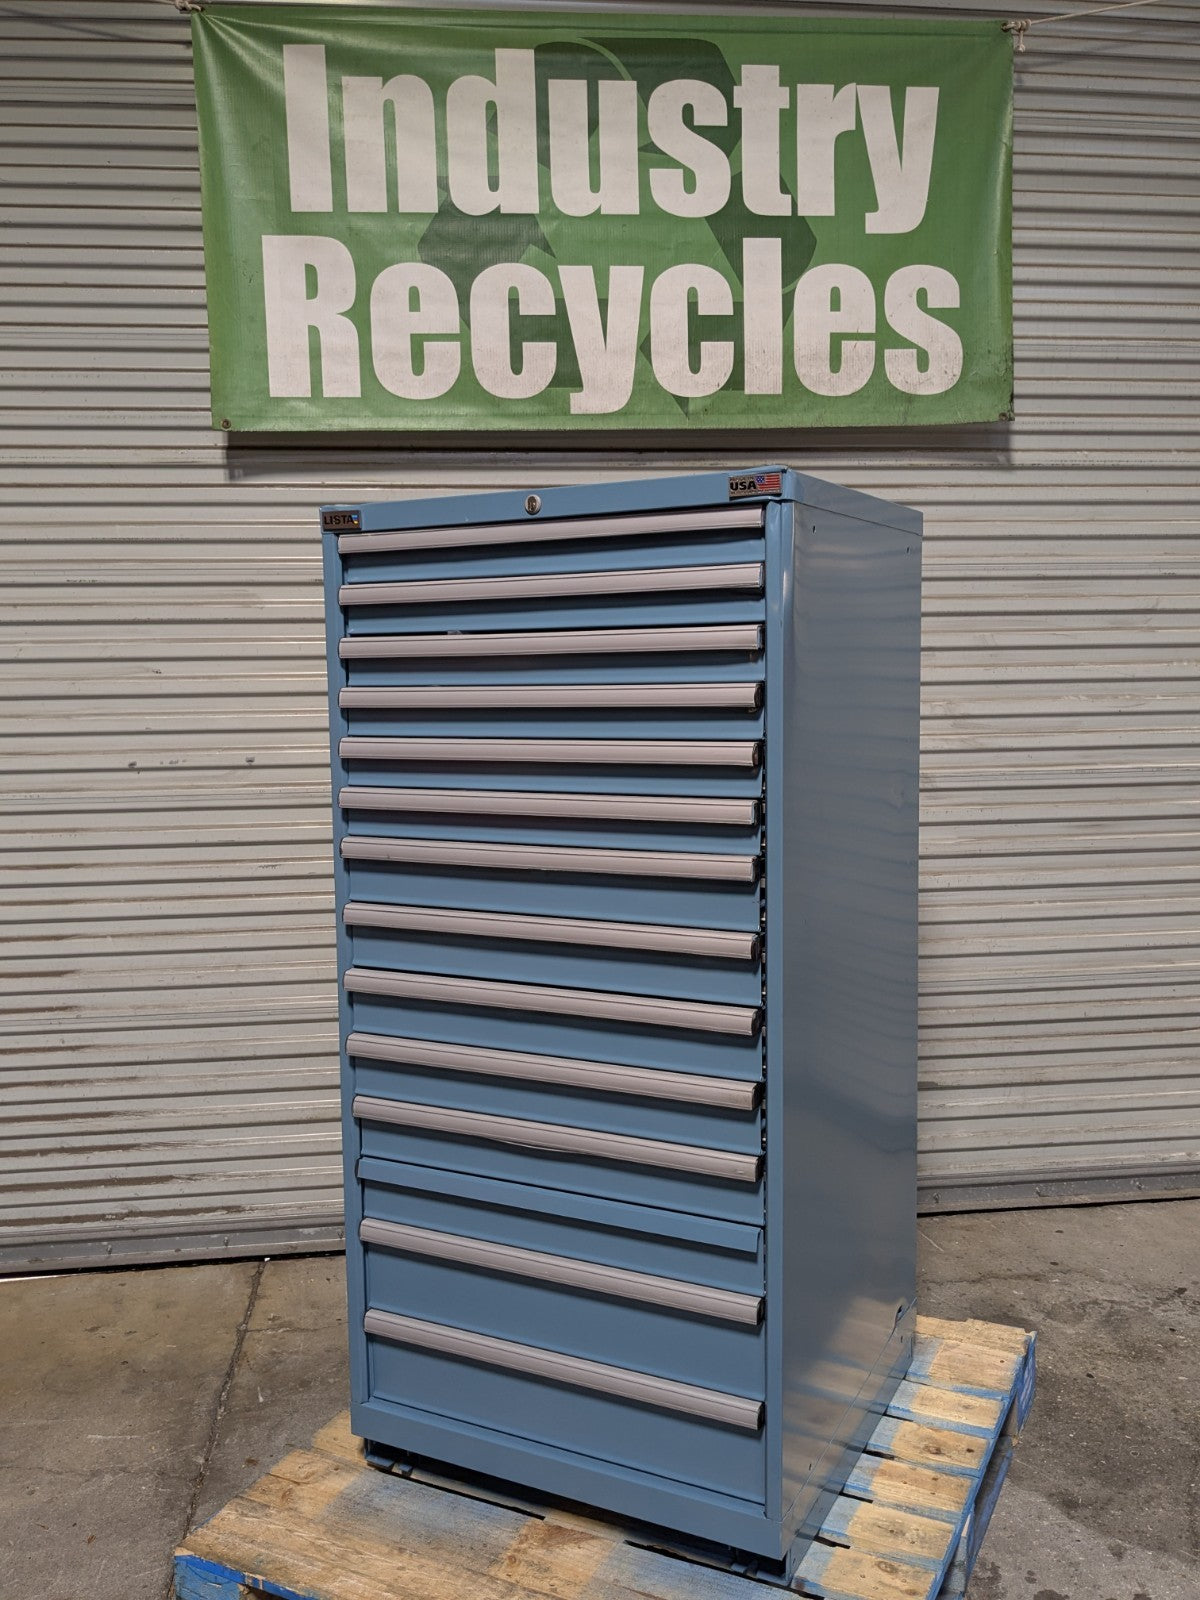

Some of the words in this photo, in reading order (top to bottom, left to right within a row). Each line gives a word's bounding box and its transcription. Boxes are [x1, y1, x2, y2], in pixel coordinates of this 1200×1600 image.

[283, 44, 940, 234] Industry
[261, 235, 964, 414] Recycles
[324, 515, 354, 525] LISTA
[730, 481, 757, 491] USA
